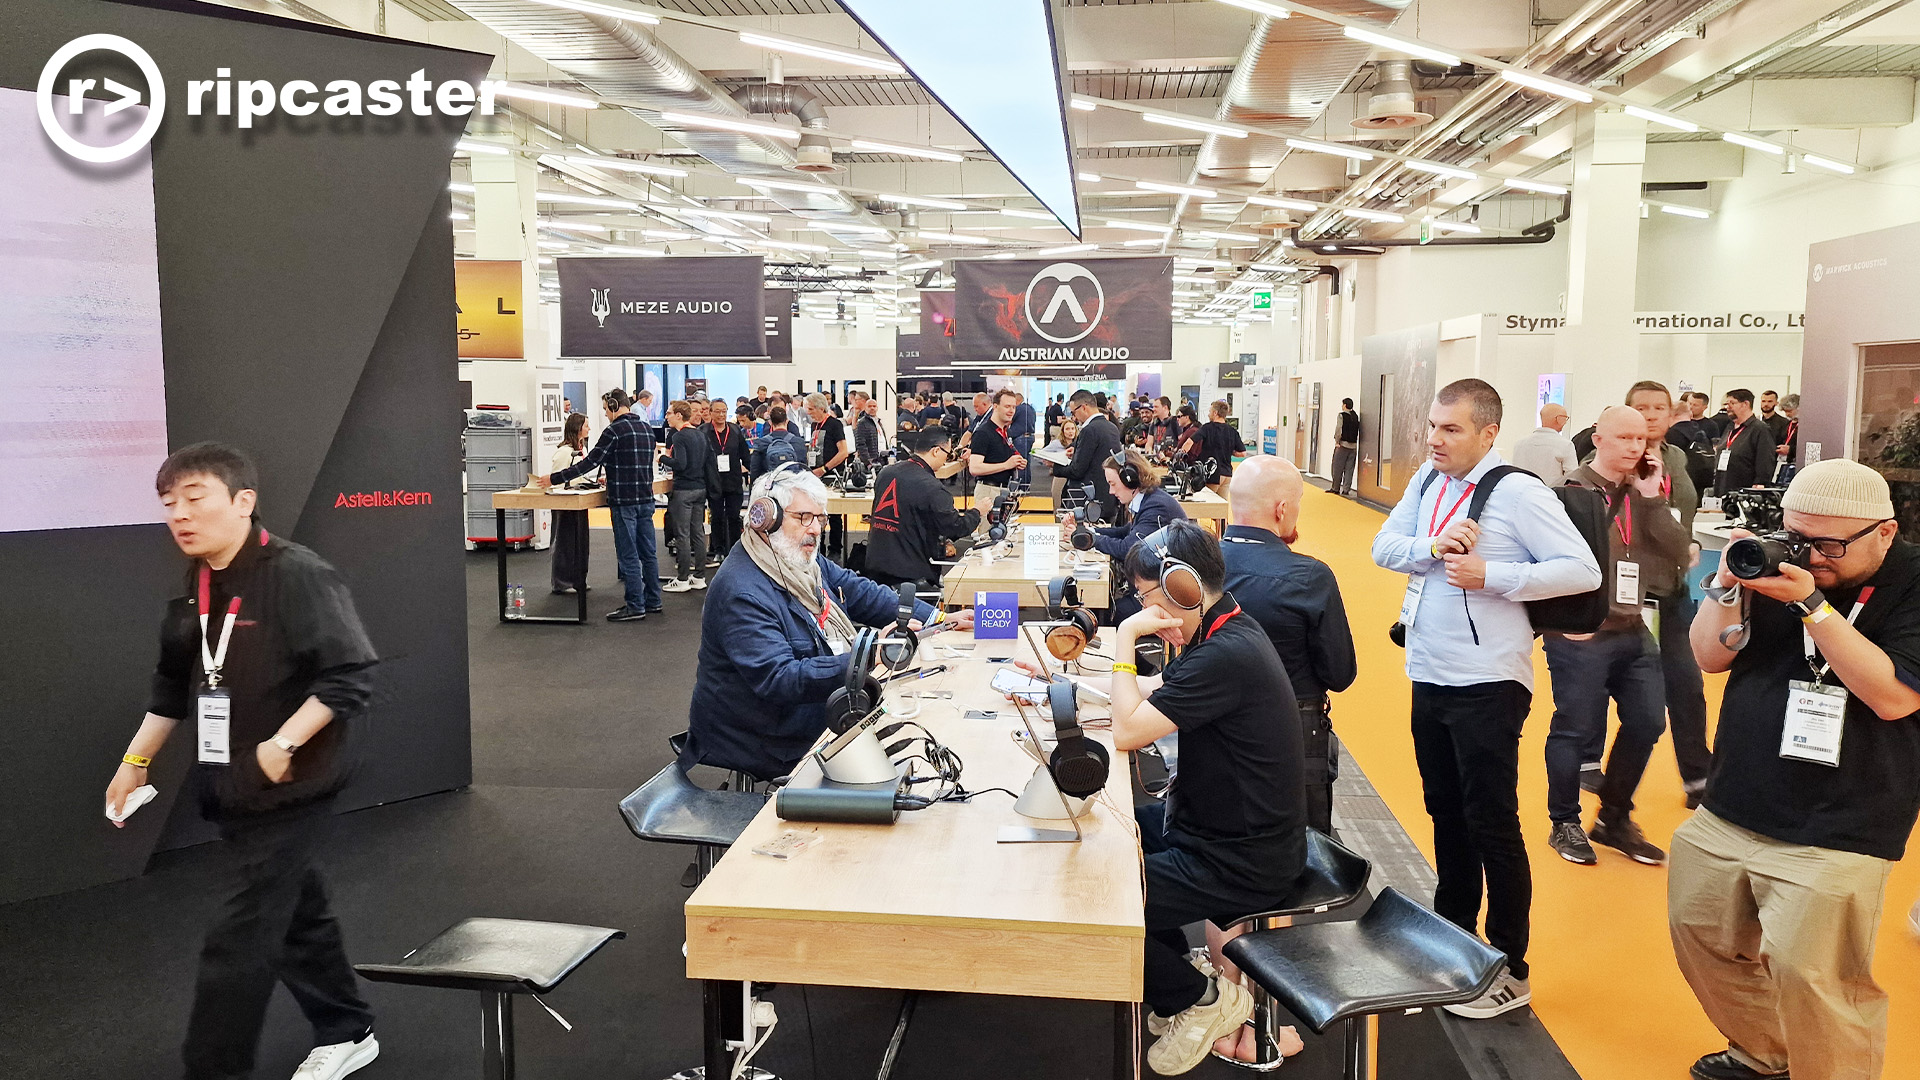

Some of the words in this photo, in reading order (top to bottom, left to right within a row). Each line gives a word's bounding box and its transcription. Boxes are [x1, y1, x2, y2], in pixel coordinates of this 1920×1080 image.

[1853, 257, 1888, 271] ACOUSTICS
[620, 301, 670, 314] MEZE
[675, 300, 733, 314] AUDIO
[1632, 313, 1732, 329] rnational
[1739, 313, 1778, 330] Co.,
[998, 347, 1074, 361] AUSTRIAN
[1078, 347, 1130, 361] AUDIO
[541, 394, 562, 423] HFN
[334, 490, 433, 508] Astell&Kern
[981, 608, 1012, 619] roon
[981, 619, 1012, 628] READY
